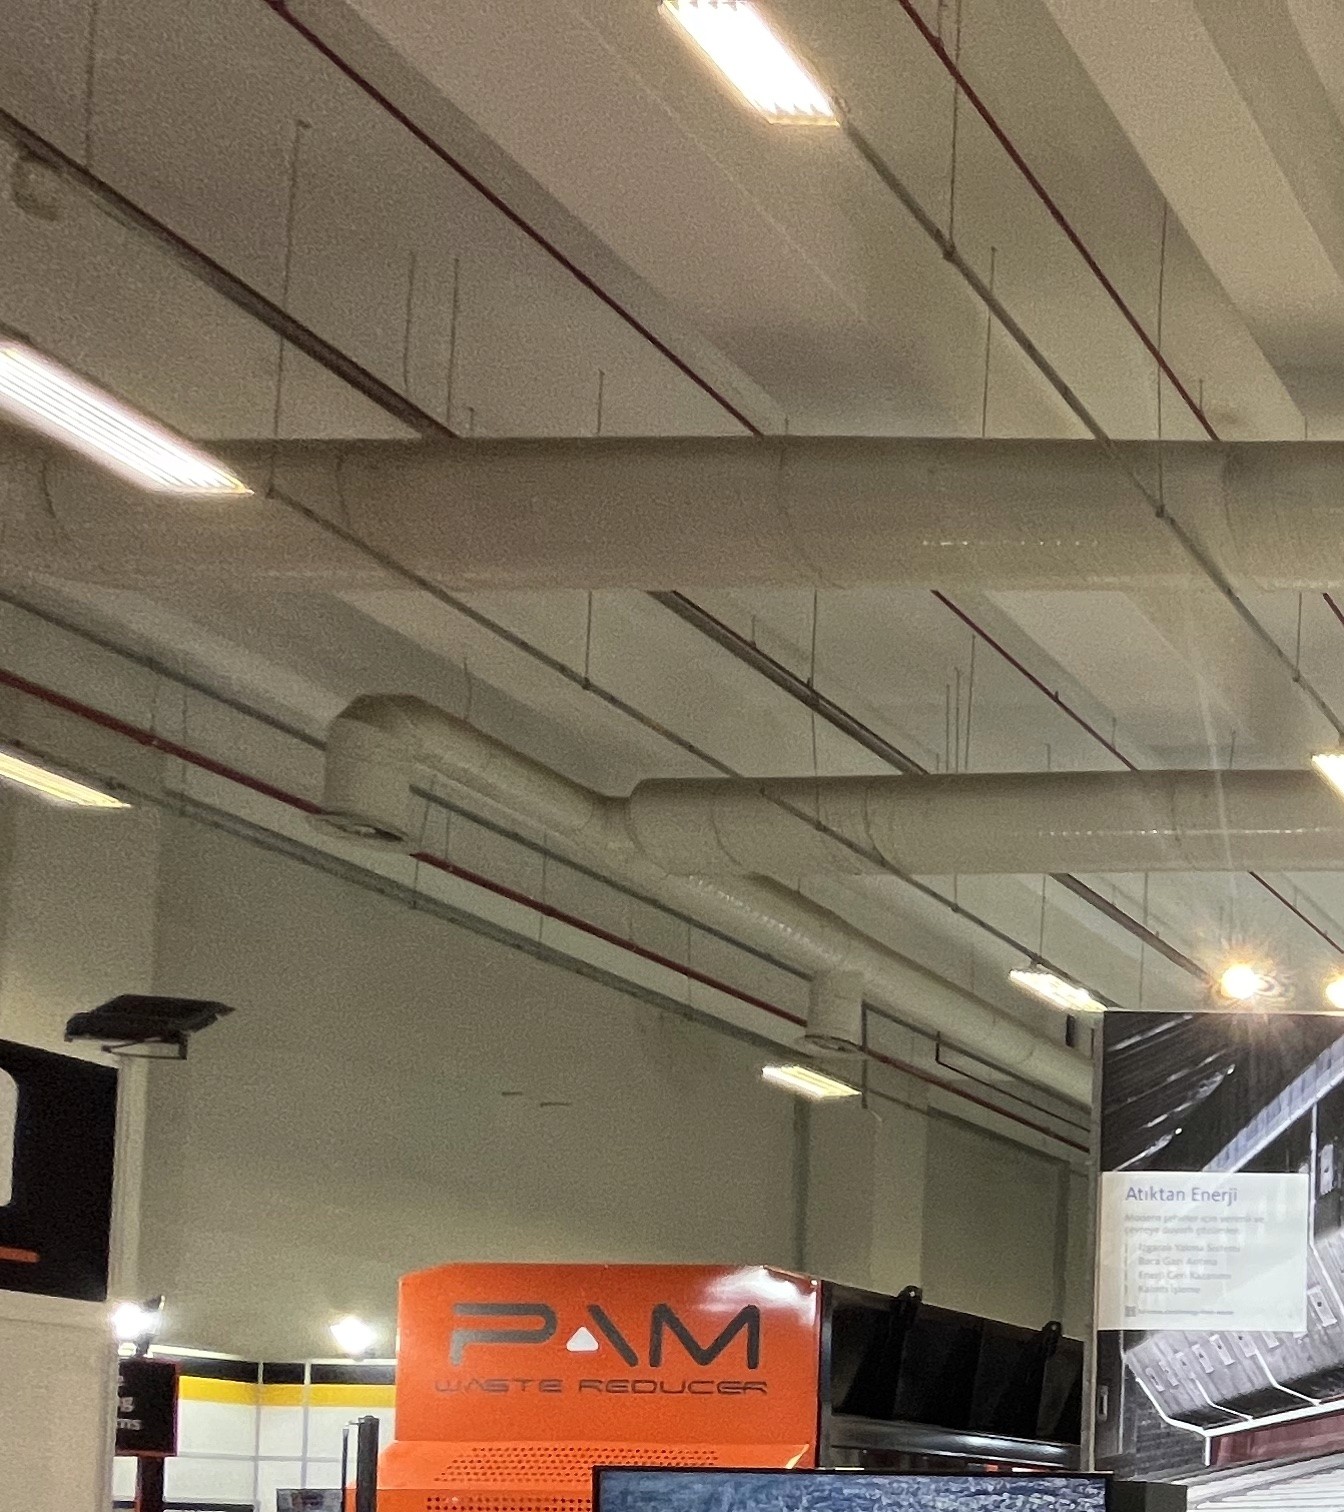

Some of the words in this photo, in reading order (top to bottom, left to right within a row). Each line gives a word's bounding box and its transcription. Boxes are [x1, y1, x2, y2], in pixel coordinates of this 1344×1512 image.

[1126, 1186, 1185, 1201] Atıktan
[1191, 1187, 1238, 1207] Enerji
[449, 1303, 761, 1370] PAM
[435, 1378, 564, 1394] WASTE
[578, 1379, 768, 1396] REDUCER
